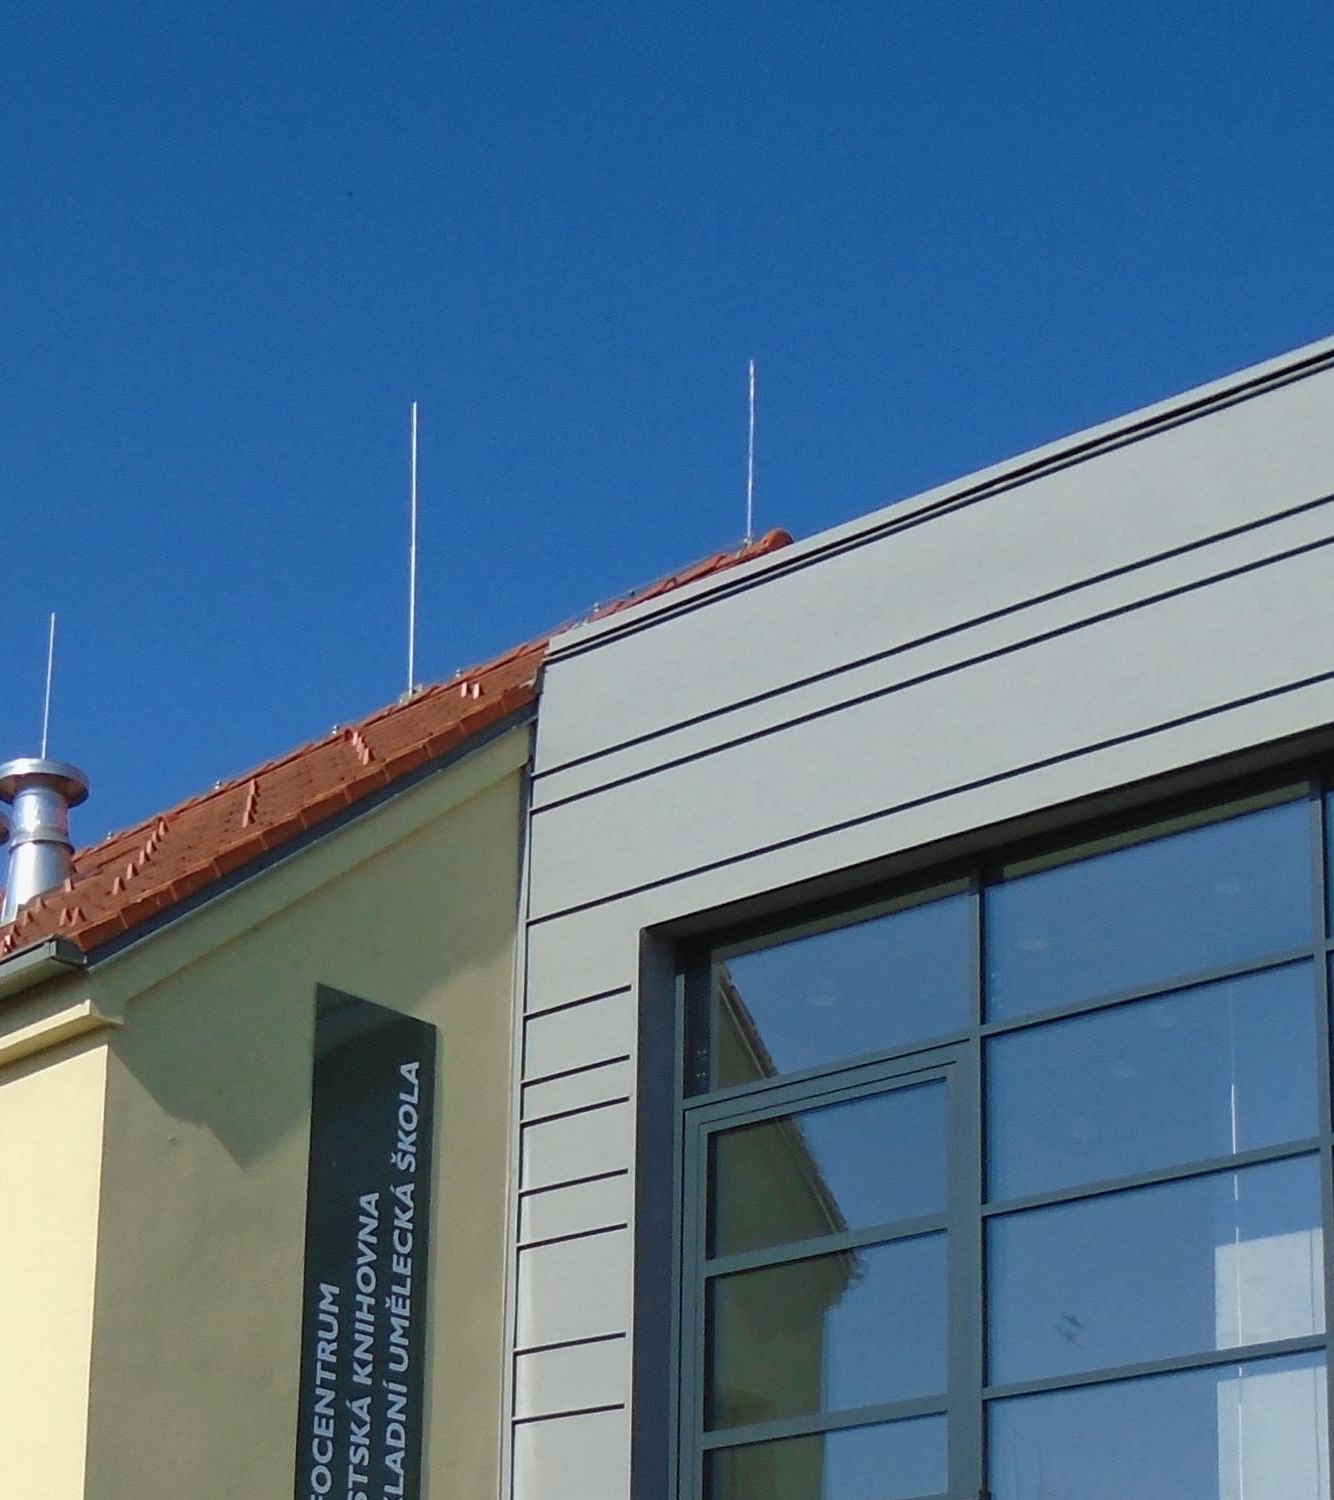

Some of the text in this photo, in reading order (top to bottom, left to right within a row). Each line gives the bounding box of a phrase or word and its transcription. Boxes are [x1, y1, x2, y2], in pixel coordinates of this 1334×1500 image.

[390, 1061, 420, 1173] ŠKOLA
[352, 1191, 380, 1385] KNIHOVNA
[384, 1182, 415, 1372] UMĚLECKÁ
